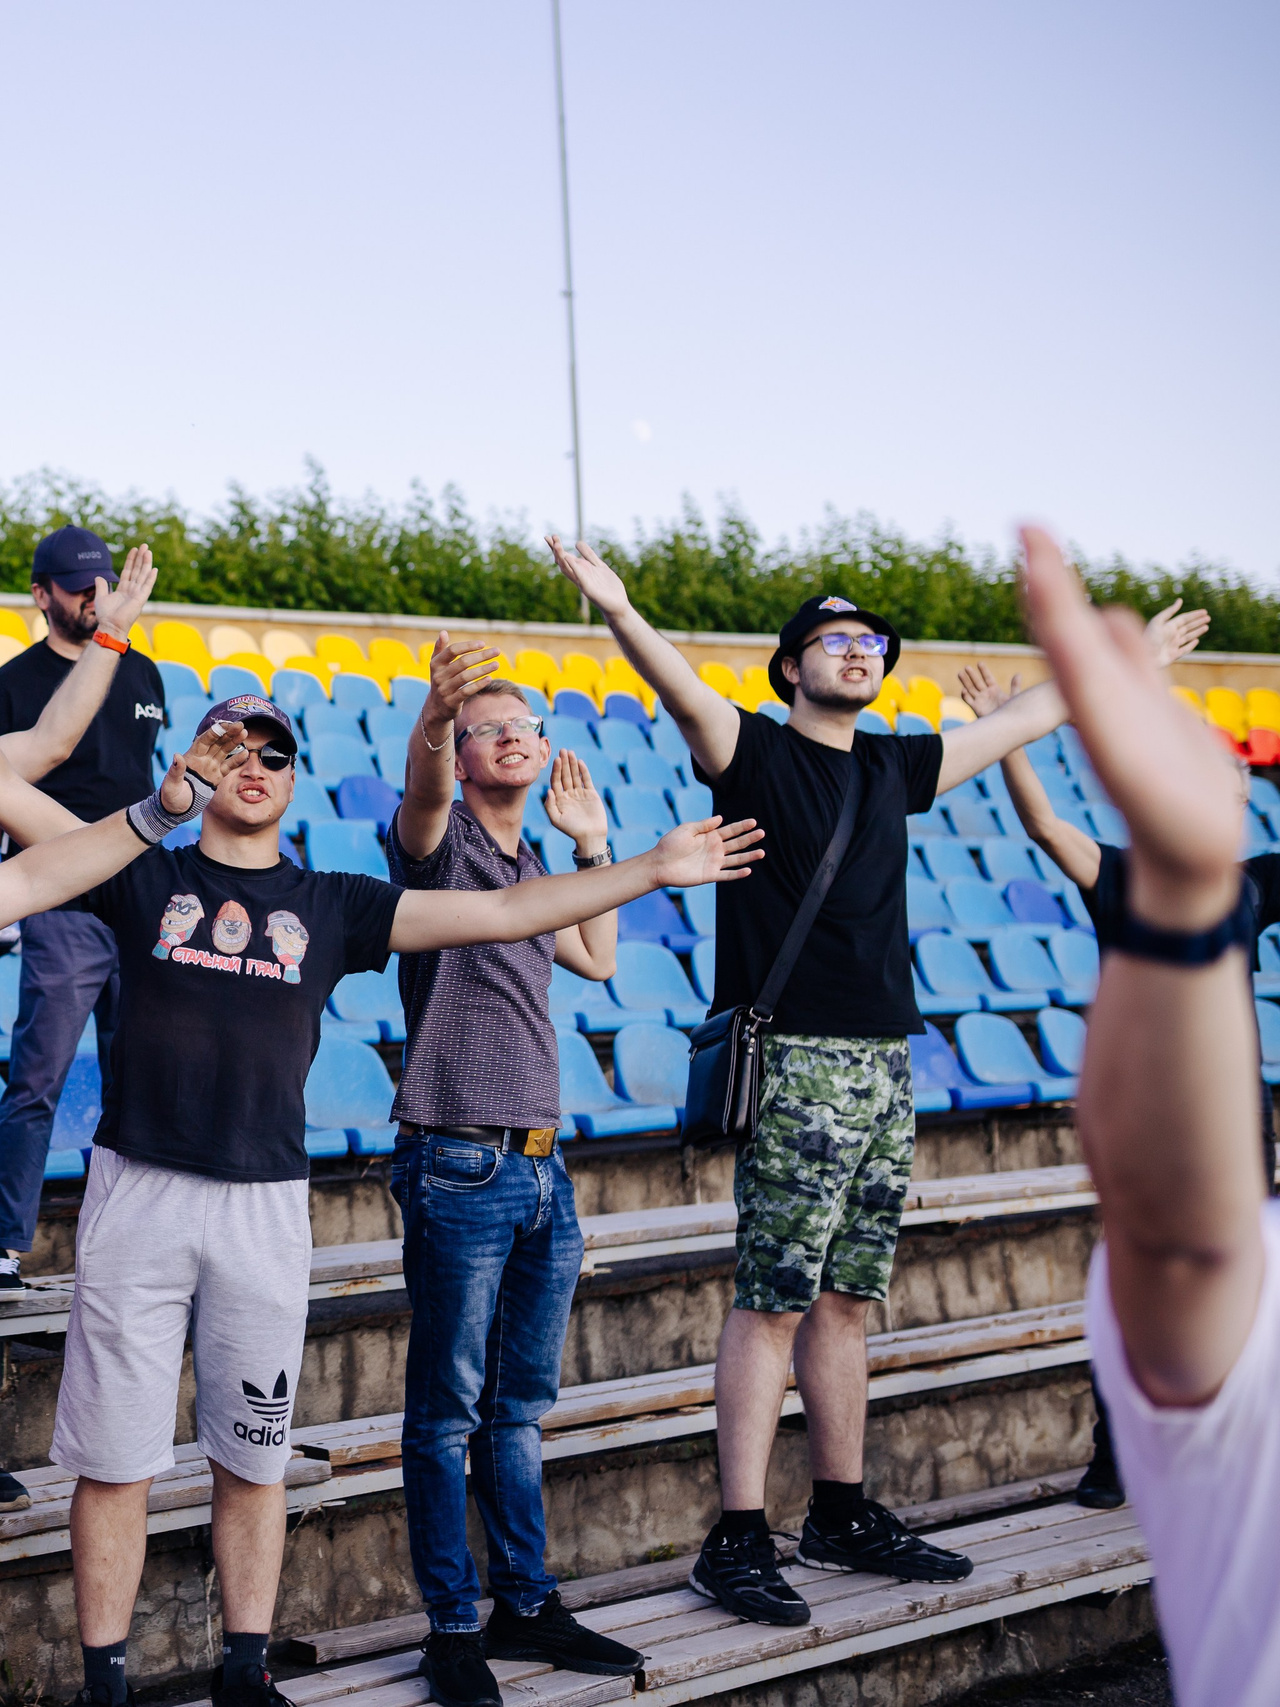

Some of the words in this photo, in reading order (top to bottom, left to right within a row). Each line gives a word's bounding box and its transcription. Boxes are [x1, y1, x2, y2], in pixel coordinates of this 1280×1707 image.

[77, 551, 102, 560] HUGO
[171, 946, 242, 975] СТАЛЬНОЙ
[245, 958, 282, 979] ГРАД
[233, 1421, 286, 1447] adid
